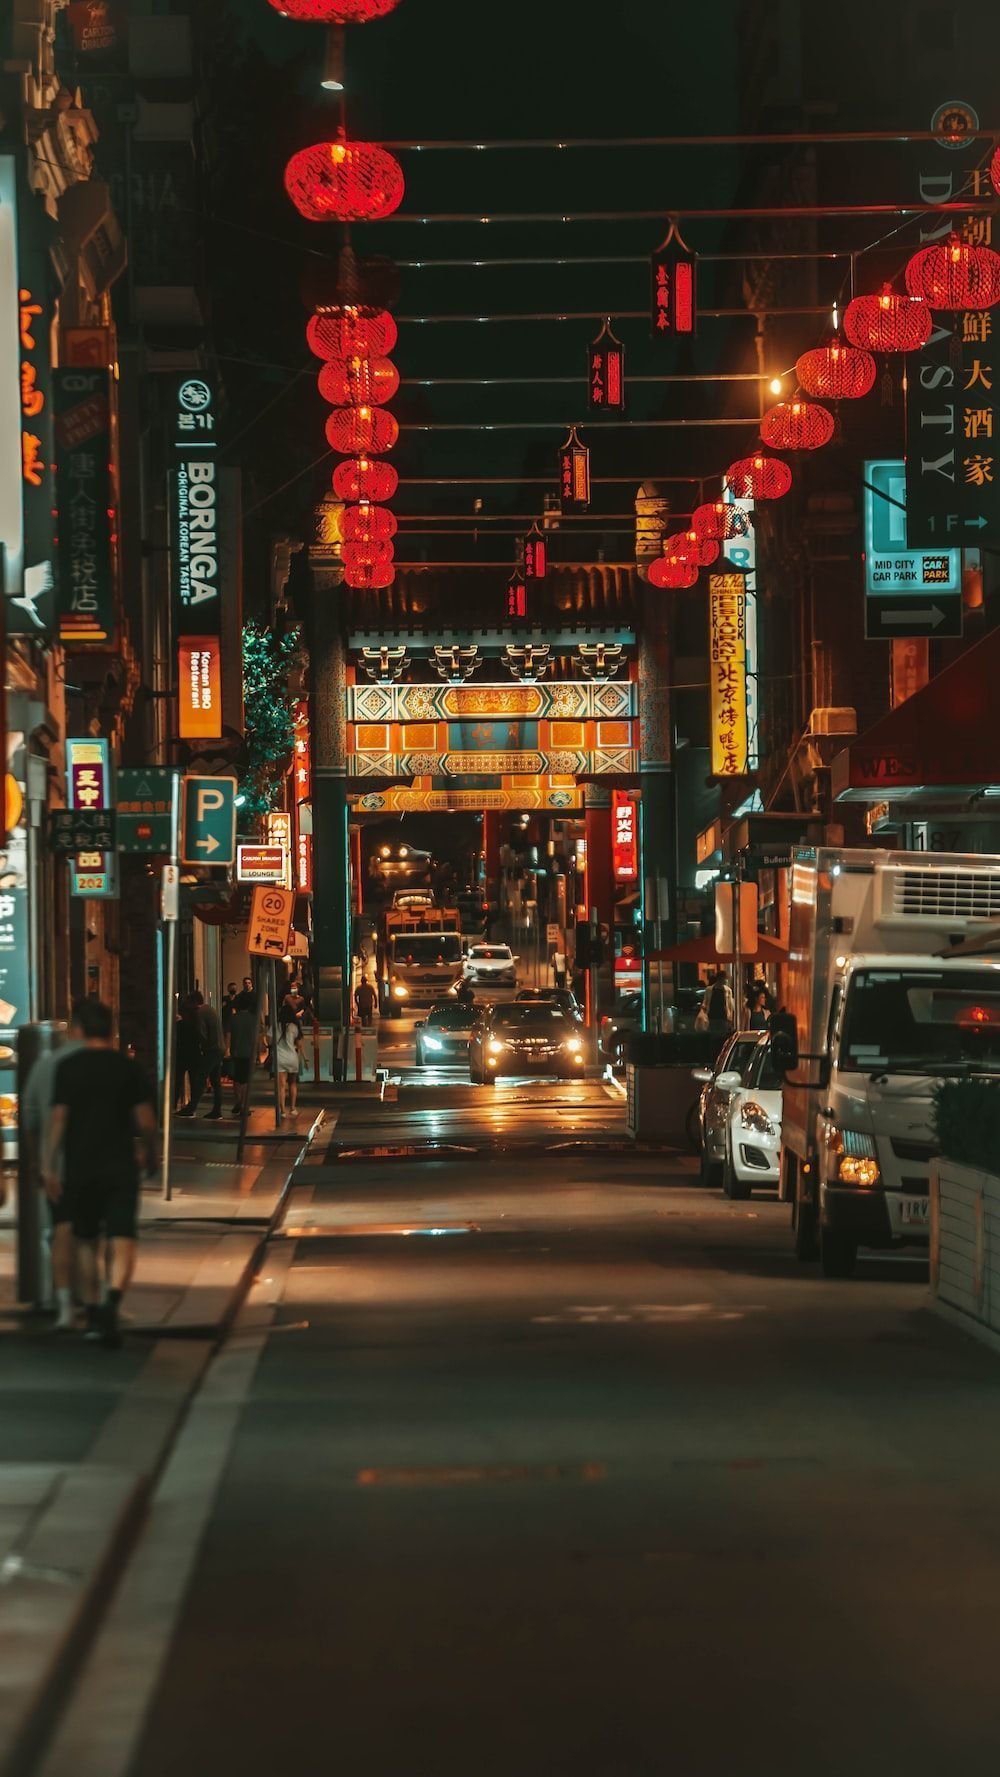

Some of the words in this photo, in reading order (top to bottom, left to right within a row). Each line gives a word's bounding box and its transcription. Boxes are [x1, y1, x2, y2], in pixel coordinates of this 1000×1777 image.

[180, 521, 189, 562] KOREAN
[188, 461, 218, 605] BORNGA
[873, 572, 891, 582] CAR
[894, 571, 917, 581] PARK
[875, 561, 892, 570] MID
[895, 560, 915, 569] CITY
[924, 570, 949, 579] PARK
[711, 595, 720, 661] PEKING
[719, 595, 737, 662] RESTAURANT
[736, 595, 745, 640] DUCK
[190, 651, 200, 709] Restaurant
[201, 651, 211, 687] Korean
[202, 687, 212, 710] BBQ
[197, 788, 224, 822] P
[78, 877, 103, 889] 202
[265, 898, 283, 910] 20
[256, 915, 286, 927] SHARED
[260, 924, 279, 934] ZONE
